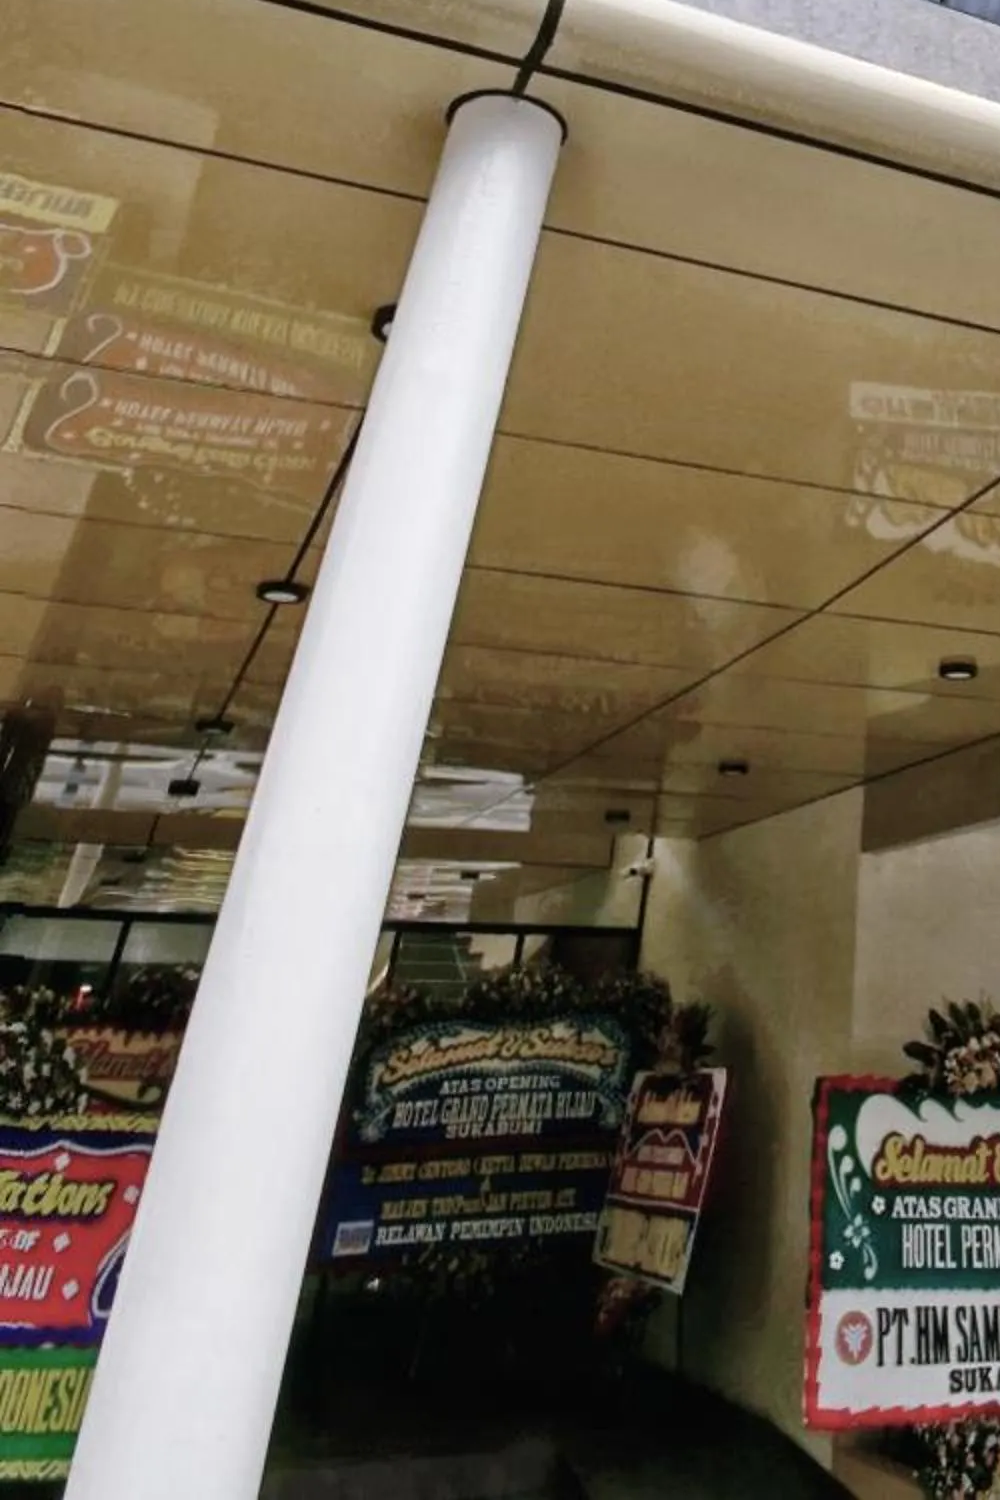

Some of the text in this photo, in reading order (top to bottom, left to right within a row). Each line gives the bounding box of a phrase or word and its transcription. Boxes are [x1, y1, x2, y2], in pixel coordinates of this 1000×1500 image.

[440, 1075, 561, 1095] ATAS OPENING
[392, 1100, 439, 1129] HOTEL
[441, 1095, 489, 1125] GRAND
[445, 1120, 543, 1140] SUKABUMI
[876, 1134, 993, 1184] Selamat
[891, 1196, 942, 1219] ATAS
[902, 1223, 957, 1270] HOTEL
